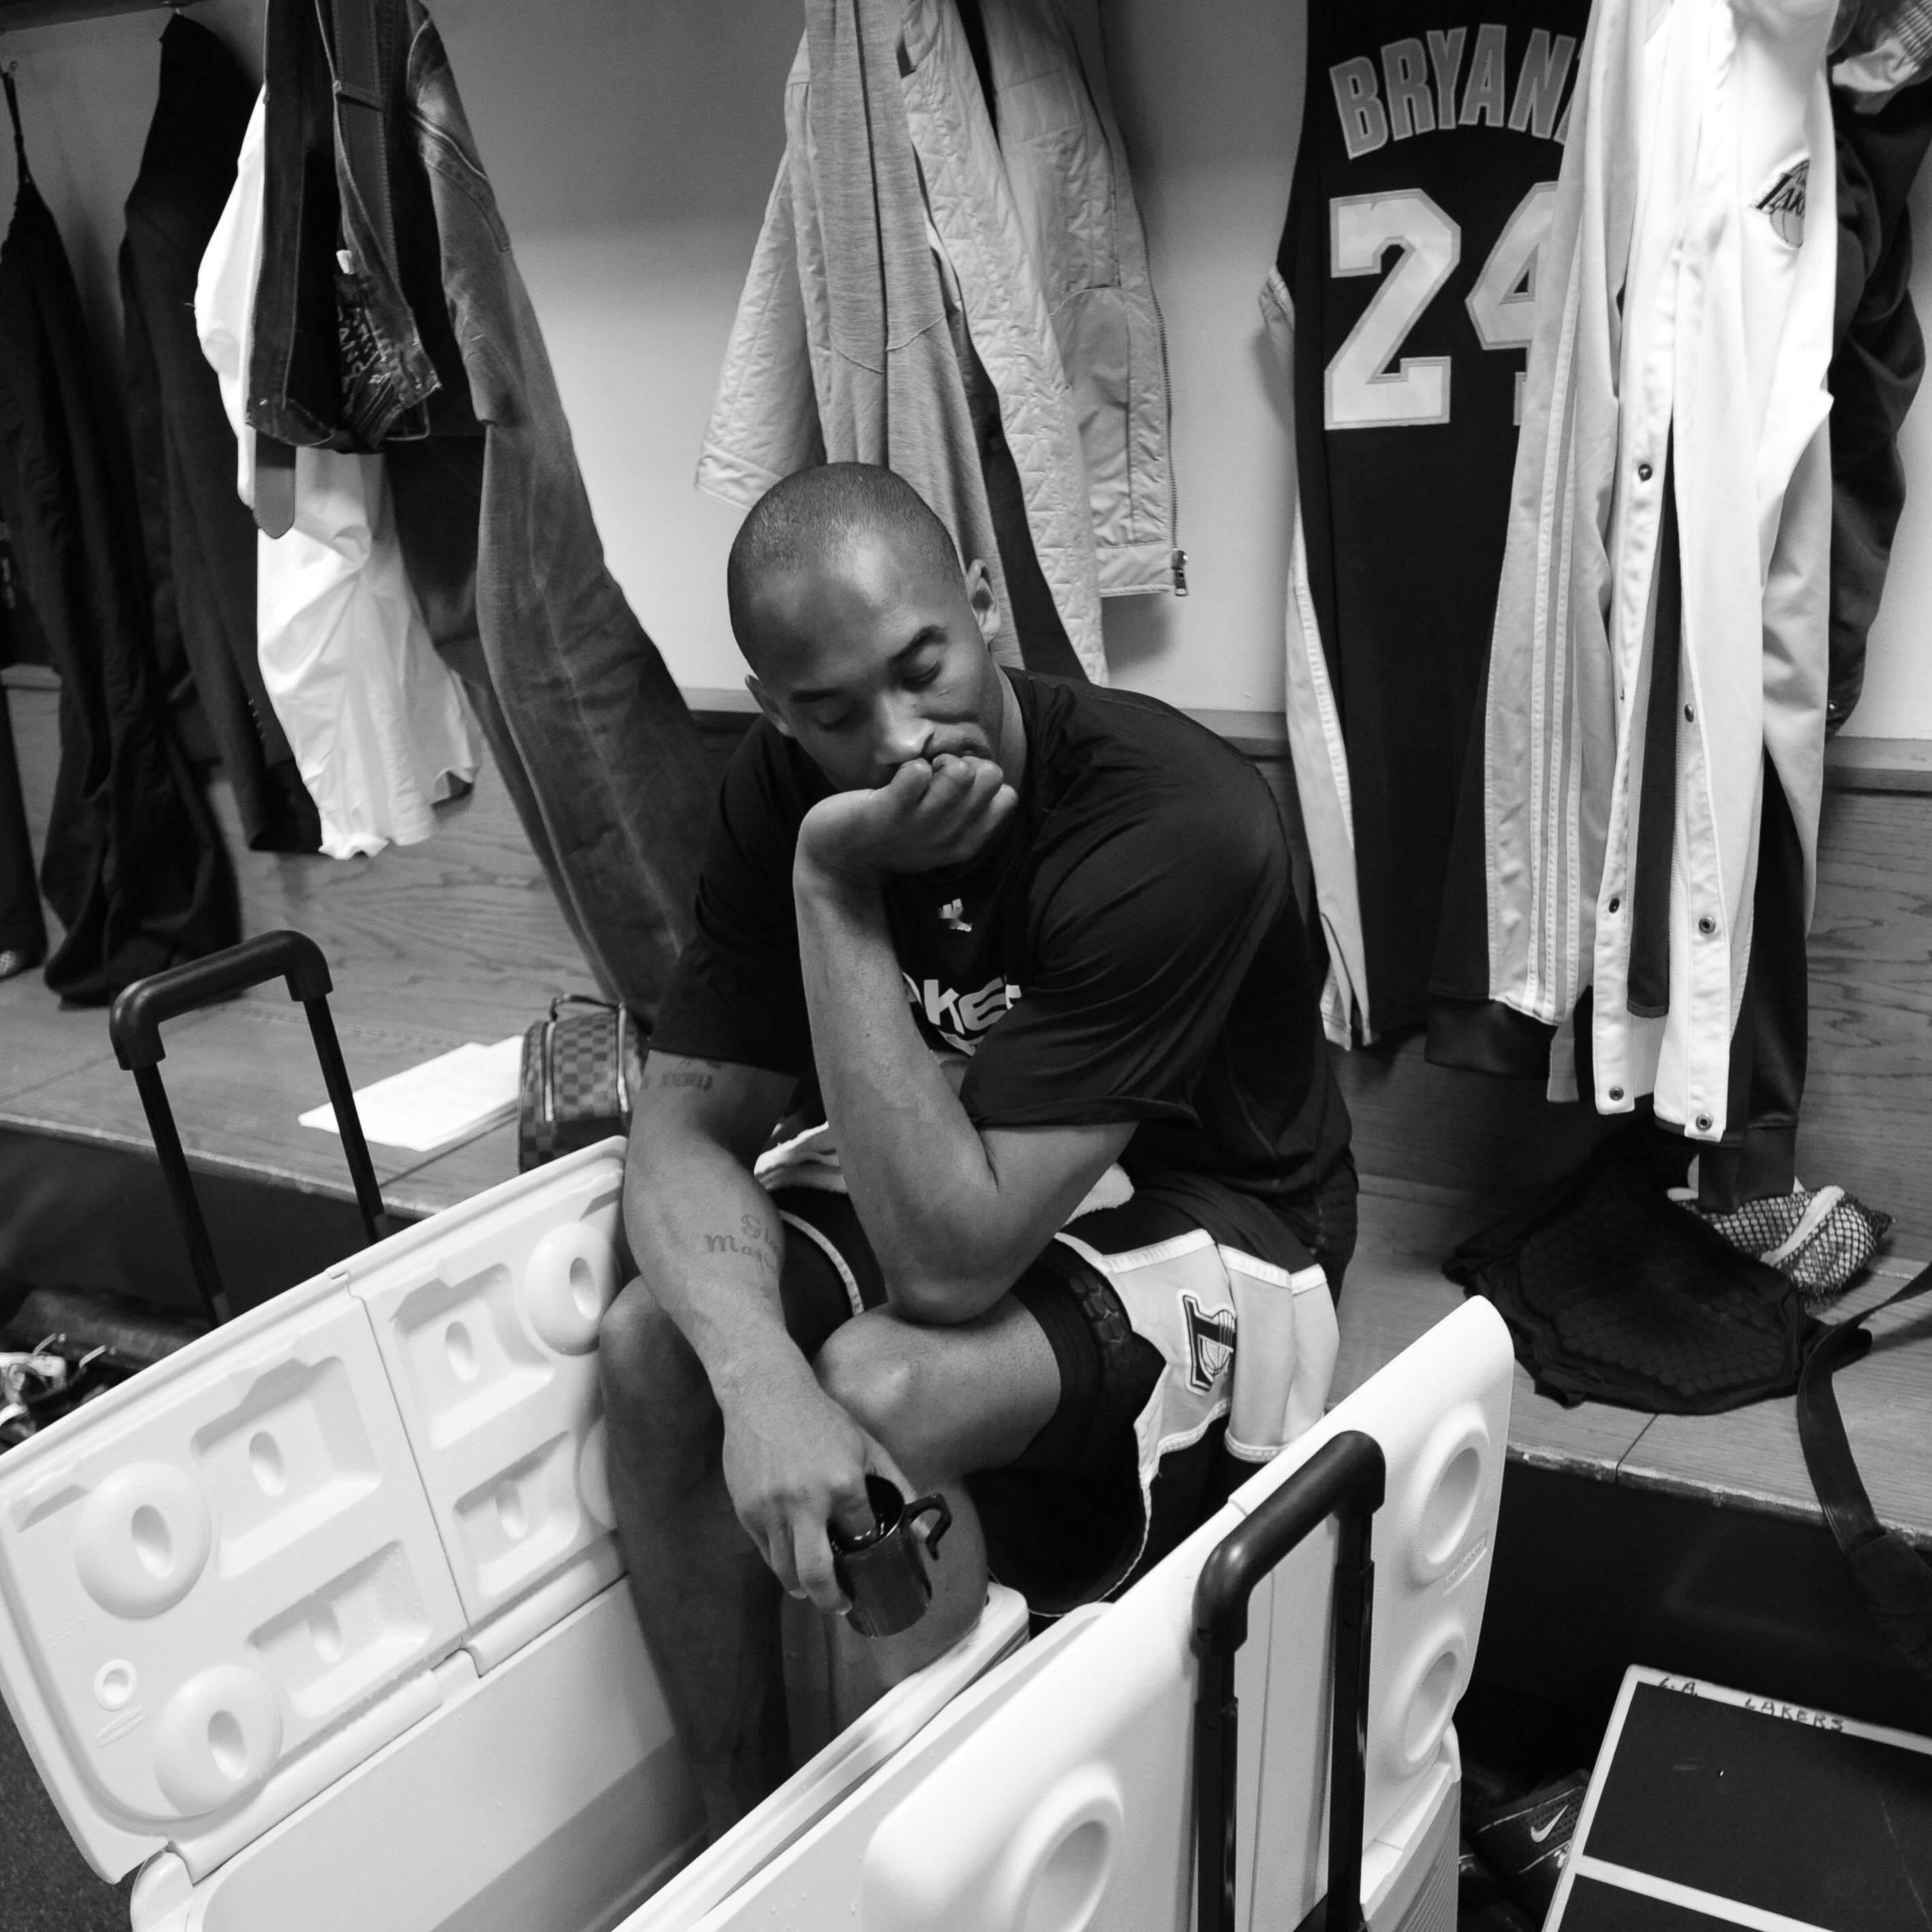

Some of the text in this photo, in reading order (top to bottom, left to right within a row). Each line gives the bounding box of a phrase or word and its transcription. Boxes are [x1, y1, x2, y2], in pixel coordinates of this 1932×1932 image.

[1330, 24, 1584, 160] BRYAN
[1324, 180, 1559, 430] 24
[1659, 1678, 1843, 1733] L.A. LAKERS
